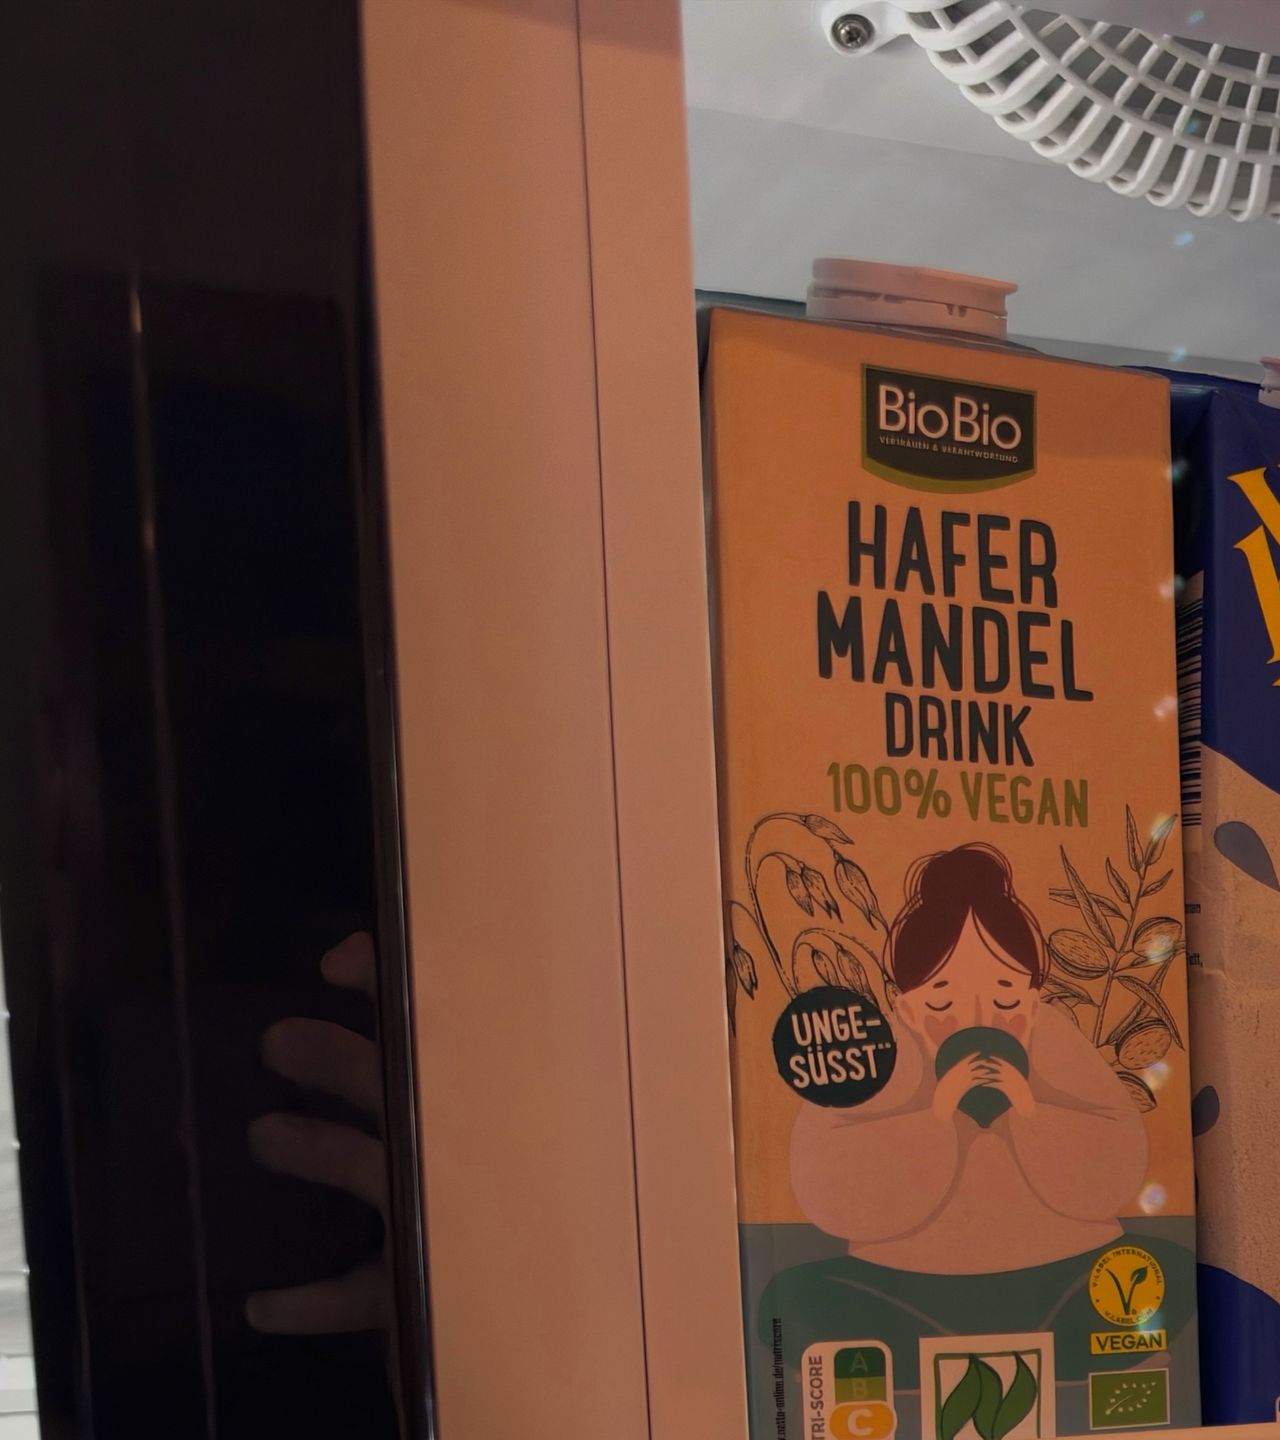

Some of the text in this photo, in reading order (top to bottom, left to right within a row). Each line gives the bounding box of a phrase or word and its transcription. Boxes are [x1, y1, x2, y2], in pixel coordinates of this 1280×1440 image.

[879, 384, 1022, 450] BioBio
[848, 500, 1058, 608] HAFER
[817, 590, 1094, 702] MANDEL
[884, 692, 1035, 767] DRINK
[827, 762, 1089, 828] 100% VEGAN
[791, 1005, 881, 1046] UNGE-
[1096, 1333, 1163, 1352] VEGAN
[847, 1408, 874, 1436] C
